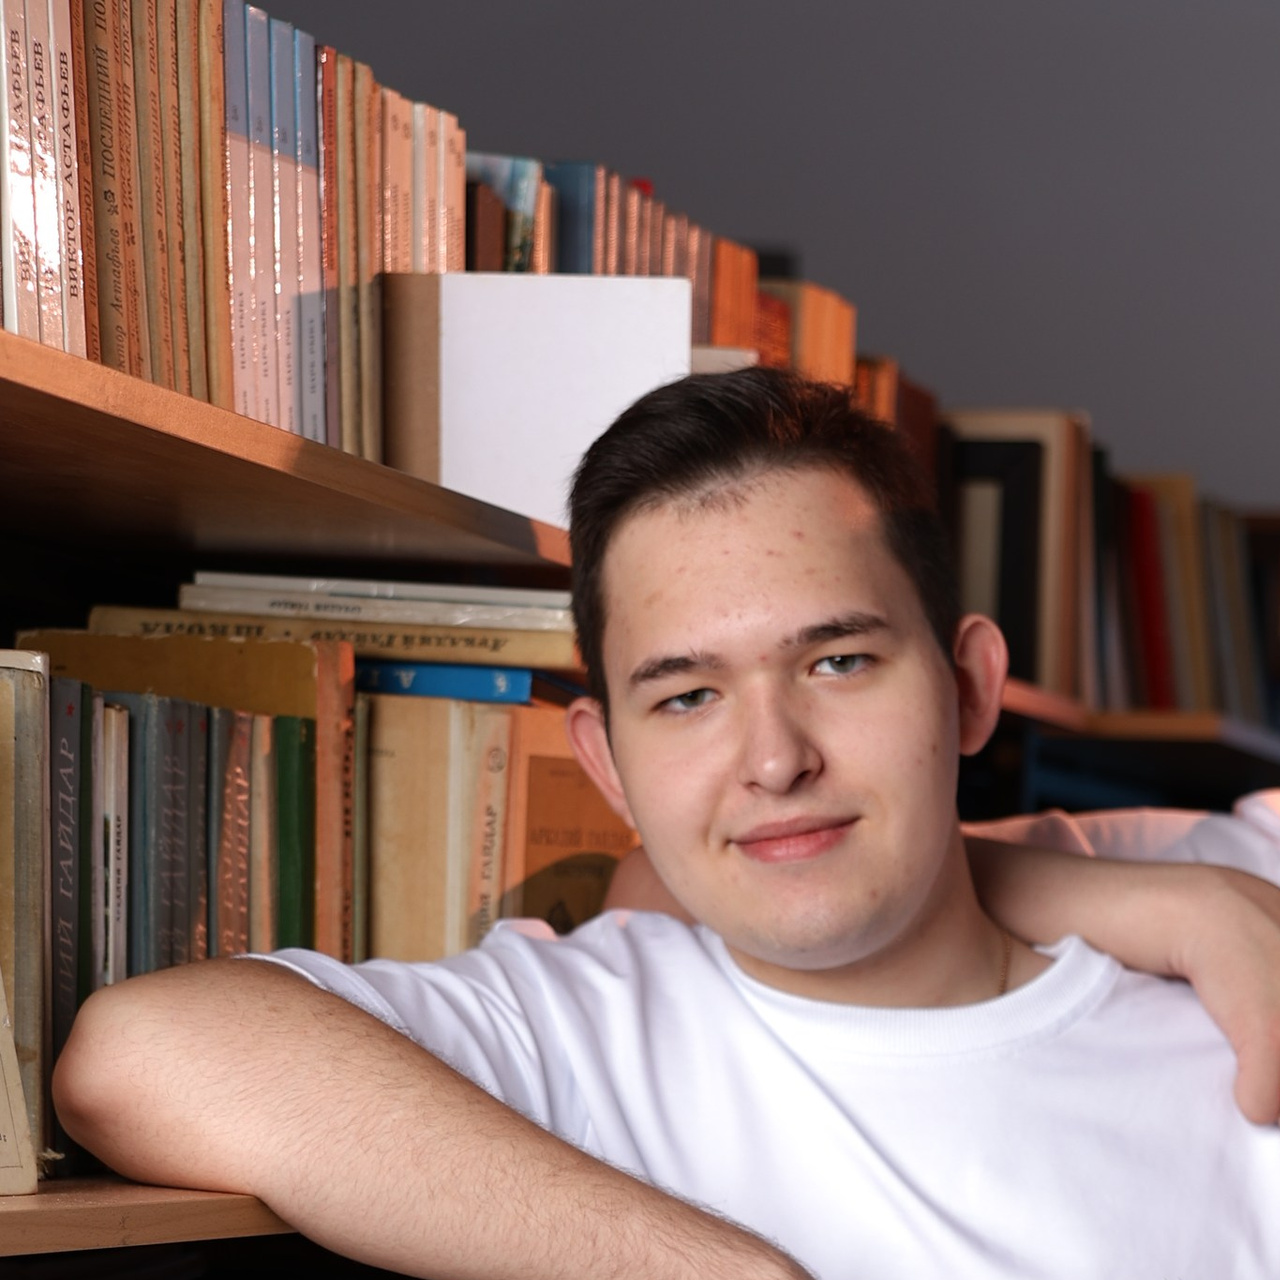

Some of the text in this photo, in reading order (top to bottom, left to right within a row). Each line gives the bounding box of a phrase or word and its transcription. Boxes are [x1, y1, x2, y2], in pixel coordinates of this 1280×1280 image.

[60, 52, 78, 299] ВИКТОР АСТАФЬЕВ
[92, 45, 116, 184] ПОСЛЕДНИЙ
[58, 737, 77, 899] ГАЙДАР
